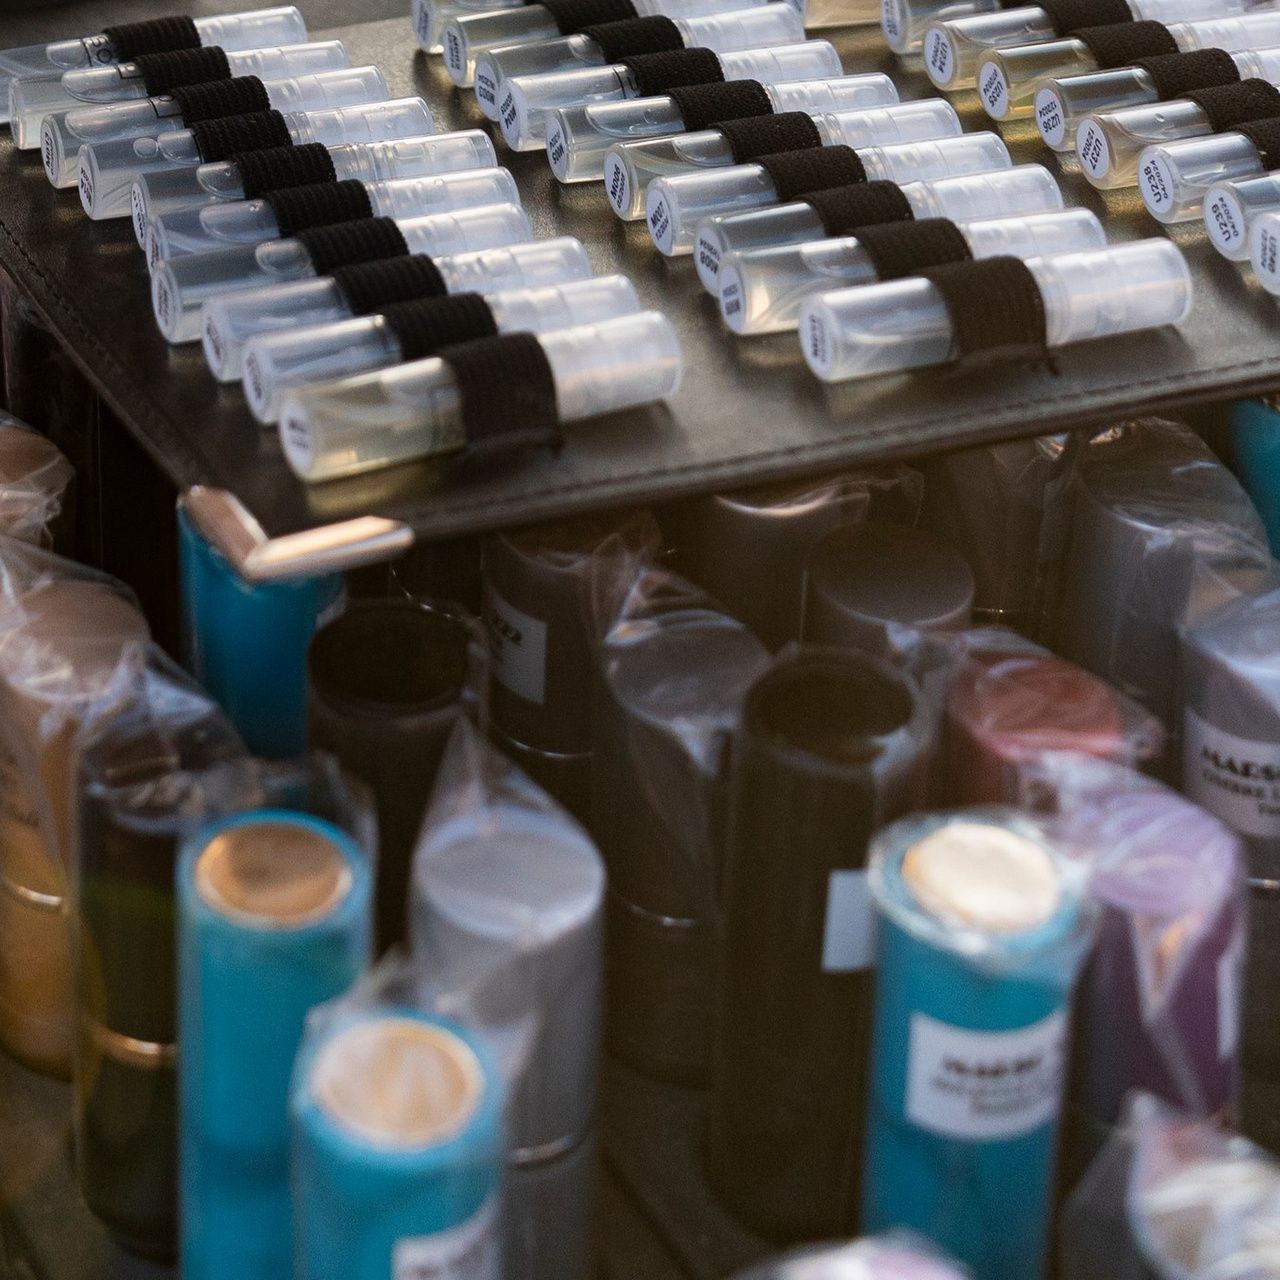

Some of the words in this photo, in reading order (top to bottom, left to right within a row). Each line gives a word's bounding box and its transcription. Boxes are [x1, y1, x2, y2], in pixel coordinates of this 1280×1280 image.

[938, 42, 948, 74] U234
[988, 81, 1003, 108] U235
[1043, 113, 1061, 133] U236
[1082, 127, 1095, 161] 12/2024
[1089, 138, 1102, 170] U237
[611, 164, 620, 200] M006
[1144, 166, 1162, 204] U238
[1150, 159, 1168, 199] 04/2024
[1211, 204, 1231, 242] U239
[1219, 197, 1239, 237] 04/2024
[1268, 236, 1276, 274] U240
